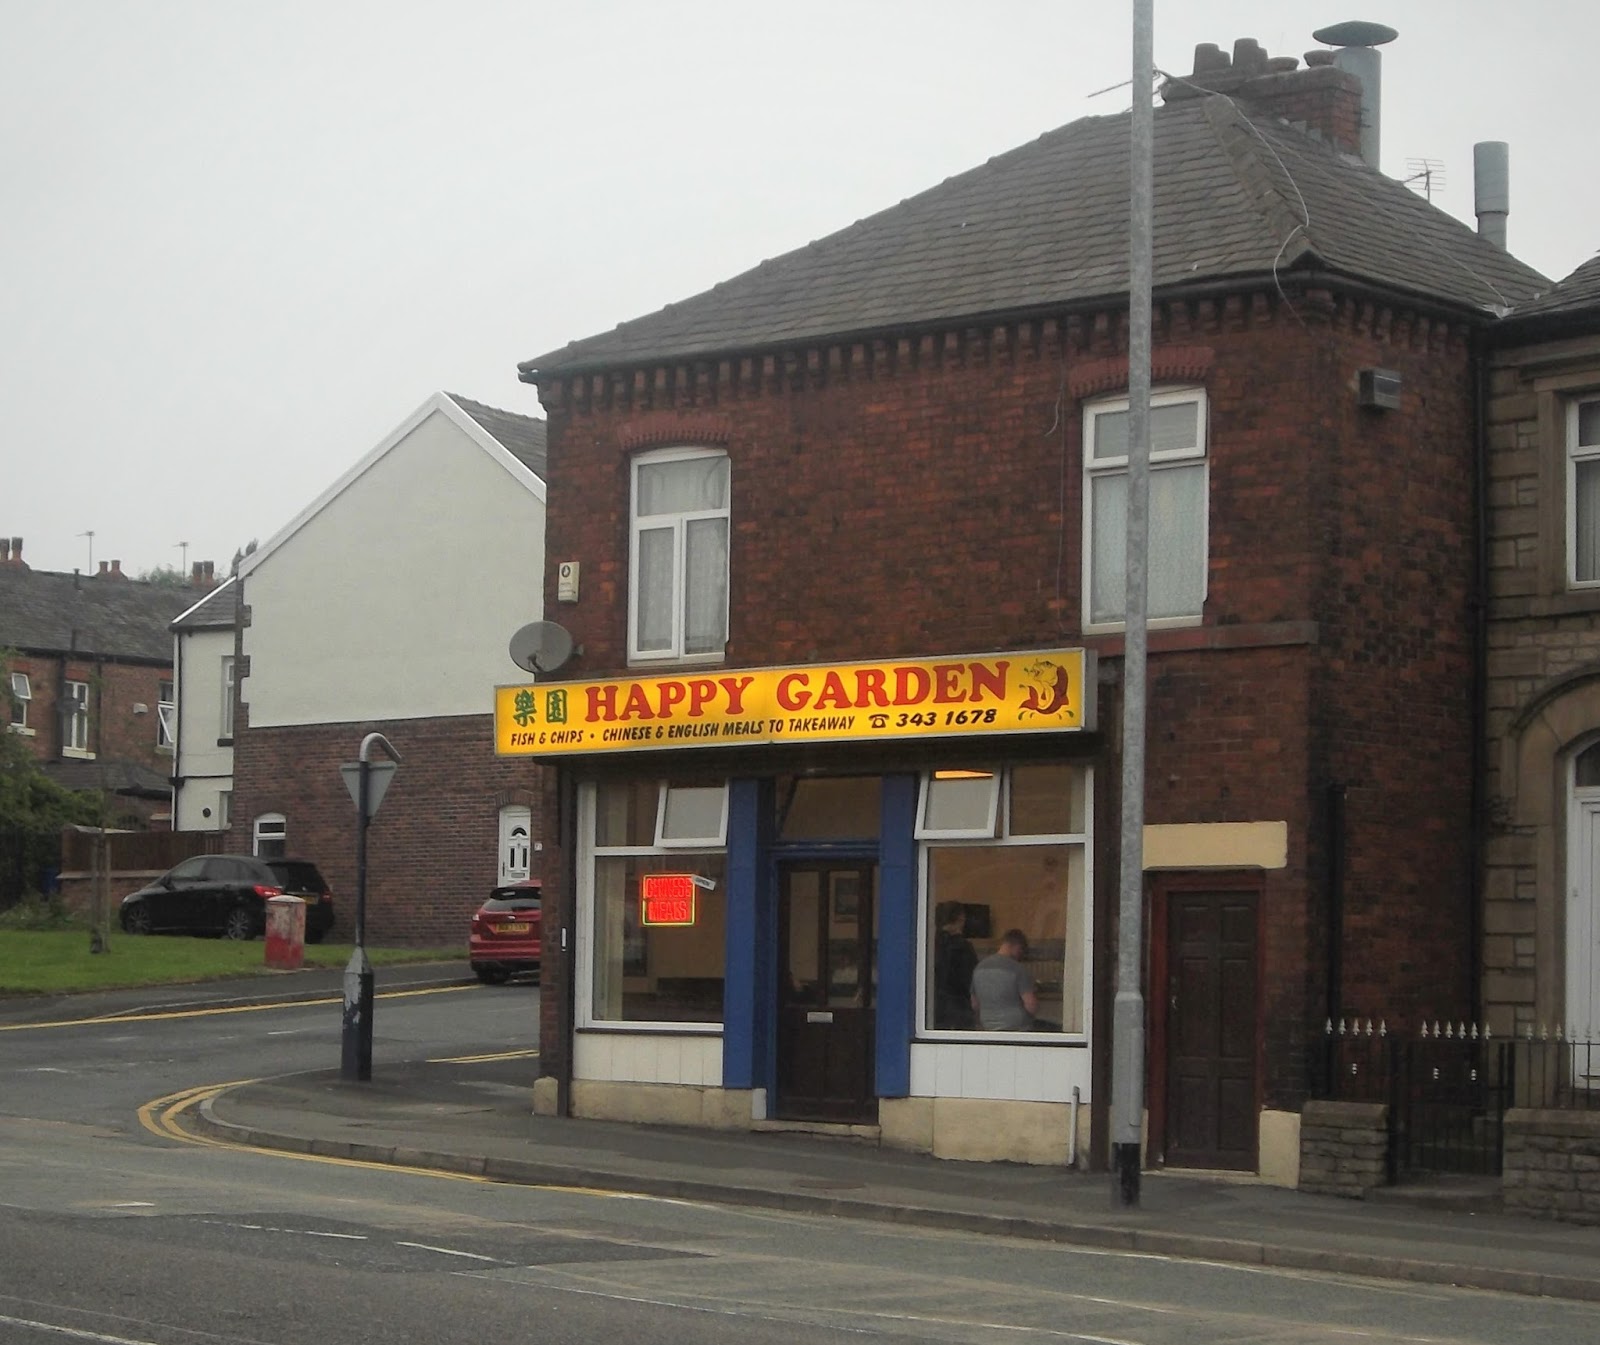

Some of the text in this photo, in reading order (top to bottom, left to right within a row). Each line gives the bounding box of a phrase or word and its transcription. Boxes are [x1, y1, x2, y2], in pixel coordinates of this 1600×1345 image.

[585, 661, 1011, 723] HAPPY GARDEN
[513, 688, 568, 727] 樂園
[896, 708, 998, 727] 343 1678
[511, 716, 855, 746] FISH & CHIPS CHINESE & ENGLISH MEALS TO TAKEAWAY
[648, 901, 688, 922] MEALS
